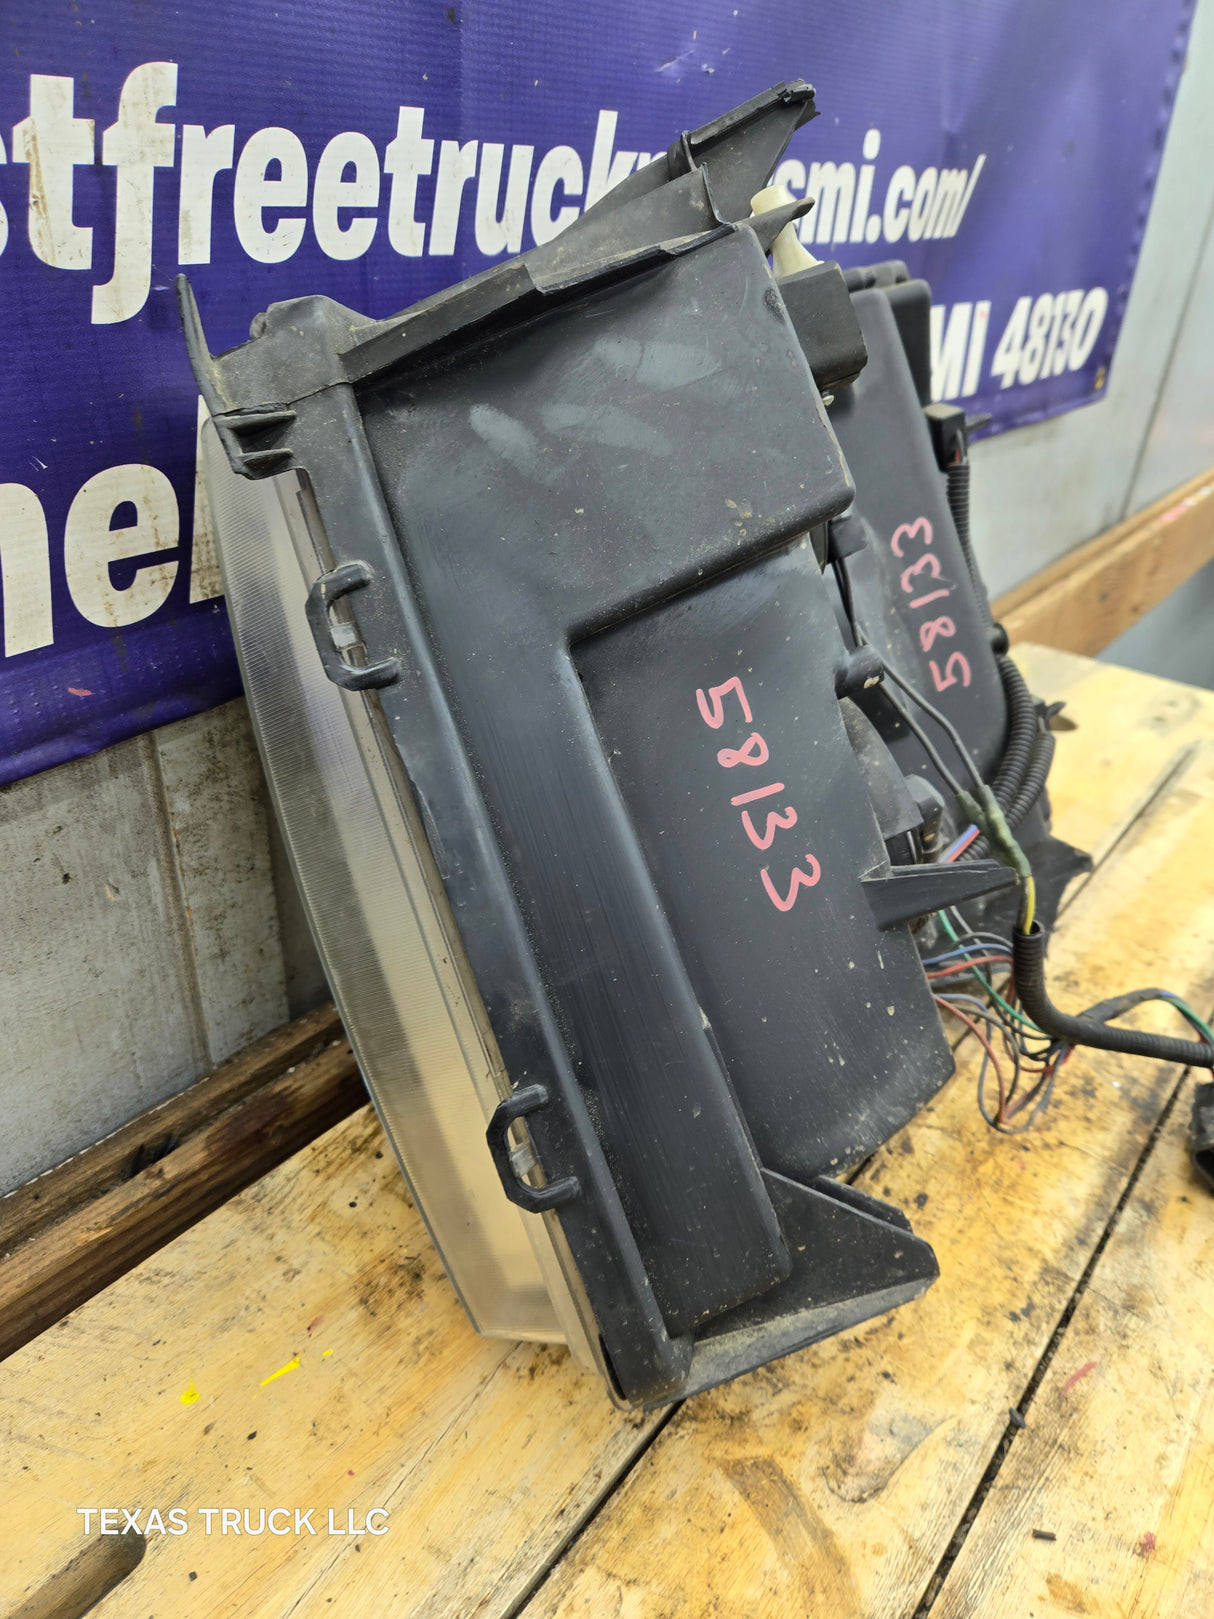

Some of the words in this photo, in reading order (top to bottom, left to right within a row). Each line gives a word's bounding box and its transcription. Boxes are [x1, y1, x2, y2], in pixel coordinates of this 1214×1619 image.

[930, 300, 992, 403] MI
[991, 286, 1109, 389] 48130
[891, 516, 972, 692] 58133
[696, 676, 821, 912] 58133
